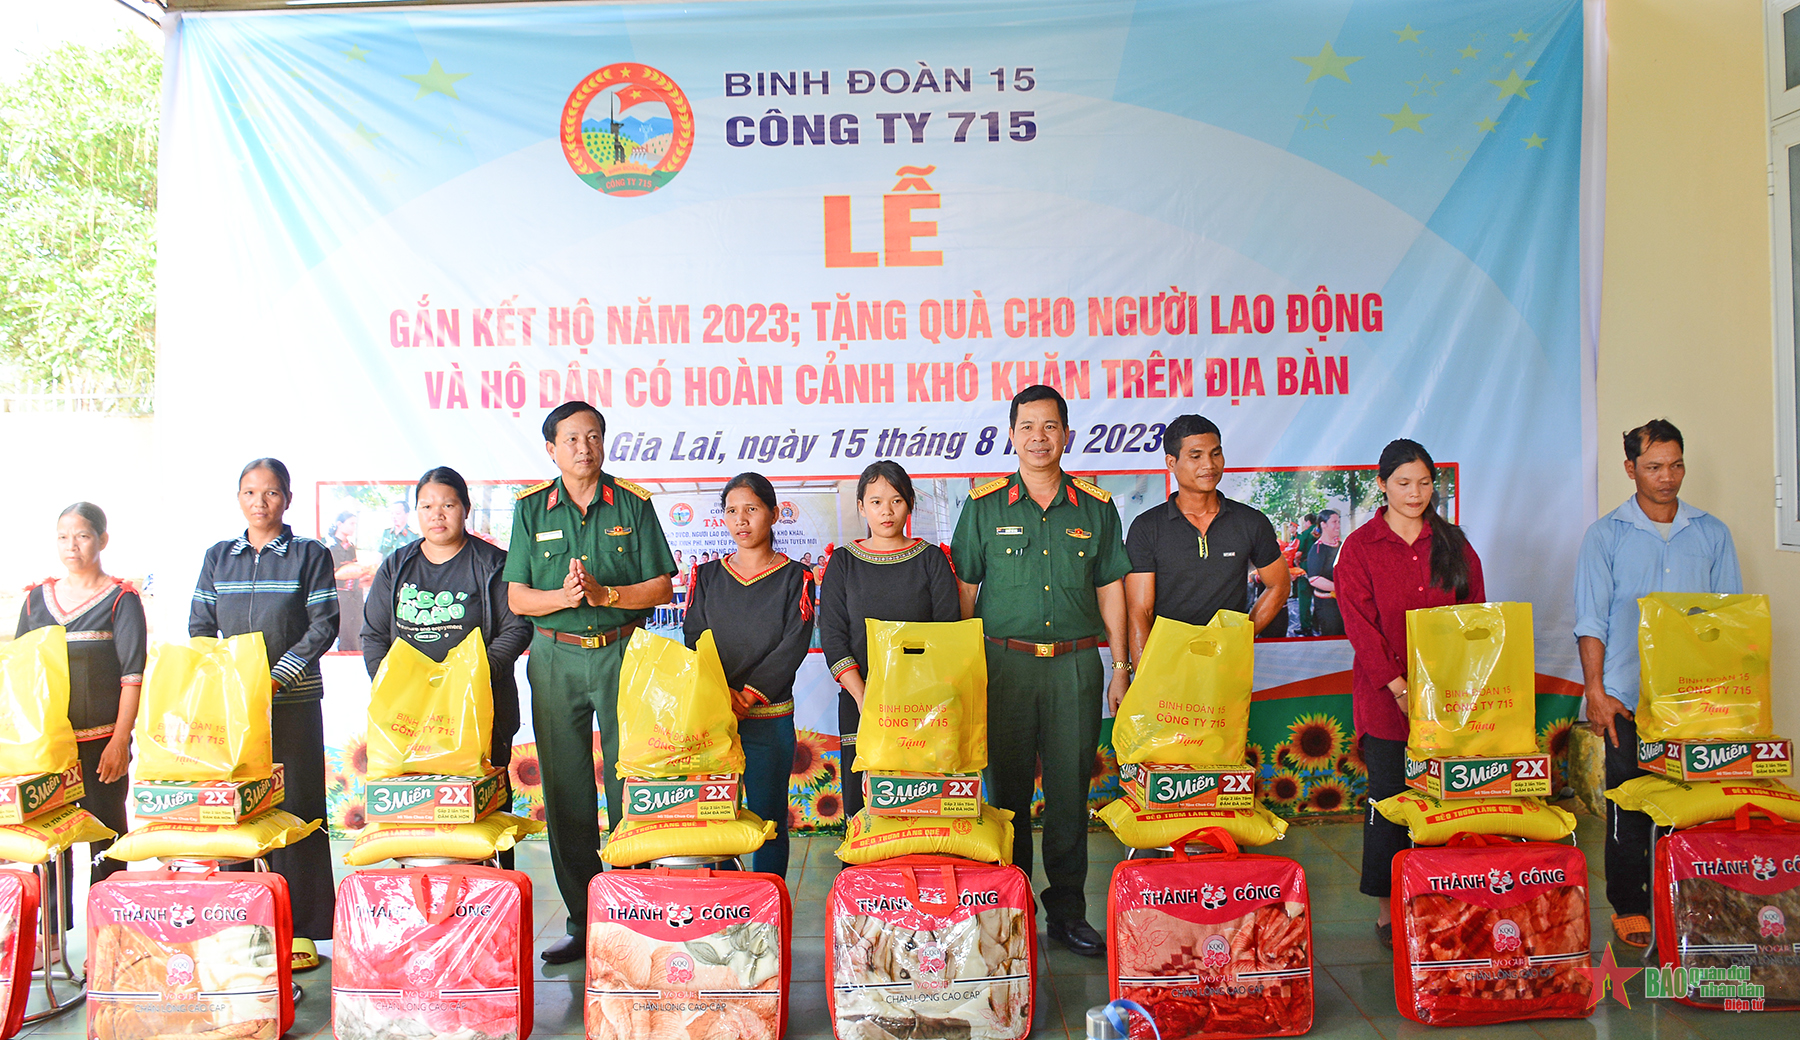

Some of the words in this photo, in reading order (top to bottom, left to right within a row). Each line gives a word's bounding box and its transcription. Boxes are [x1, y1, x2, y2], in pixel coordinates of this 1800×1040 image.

[724, 70, 830, 97] BINH
[846, 60, 972, 95] ĐOÀN
[989, 67, 1036, 93] 15
[725, 108, 860, 147] CÔNG
[875, 111, 932, 144] TY
[947, 110, 1038, 143] 715
[606, 178, 626, 189] CÔNG
[627, 178, 637, 186] TY
[639, 178, 652, 188] 715
[823, 164, 944, 269] LỄ
[389, 294, 461, 348] GẮN
[472, 294, 537, 348] KẾT
[548, 298, 595, 355] HỘ
[607, 296, 691, 346] NĂM
[702, 301, 801, 348] 2023;
[811, 292, 907, 350] TẶNG
[919, 289, 993, 343] QUÀ
[1003, 296, 1076, 338] CHO
[1088, 285, 1198, 338] NGƯỜI
[1211, 293, 1275, 335] LAO
[1287, 285, 1384, 342] ĐỘNG
[424, 358, 469, 410] VÀ
[481, 361, 526, 418] HỘ
[538, 361, 613, 408] DÂN
[625, 358, 672, 407] CÓ
[684, 357, 782, 407] HOÀN
[799, 350, 895, 405] CẢNH
[907, 353, 979, 402] KHÓ
[991, 352, 1091, 401] KHĂN
[1101, 350, 1194, 400] TRÊN
[1204, 357, 1267, 406] ĐỊA
[1276, 348, 1349, 396] BÀN
[608, 430, 666, 463] Gia
[669, 428, 727, 466] Lai,
[737, 427, 820, 467] ngày
[829, 428, 870, 458] 15
[877, 425, 967, 462] tháng
[974, 425, 999, 456] 8
[1082, 422, 1166, 454] 2023
[1678, 676, 1703, 685] BINH
[1739, 673, 1750, 681] 15
[1445, 688, 1469, 698] BINH
[1472, 685, 1498, 698] ĐOÀN
[1499, 685, 1511, 695] 15
[1678, 684, 1712, 695] CÔNG
[1717, 685, 1730, 694] TY
[1733, 685, 1752, 695] 715
[879, 703, 901, 713] BINH
[903, 702, 932, 713] ĐOÀN
[1158, 699, 1183, 711] BINH
[1185, 702, 1214, 715] ĐOÀN
[1217, 705, 1226, 714] 15
[1445, 700, 1478, 713] CÔNG
[1481, 700, 1494, 710] TY
[1497, 699, 1514, 709] 715
[396, 712, 420, 728] BINH
[879, 716, 909, 728] CÔNG
[912, 718, 926, 727] TY
[930, 717, 949, 728] 715
[1156, 712, 1189, 726] CÔNG
[1193, 717, 1207, 727] TY
[1210, 718, 1226, 728] 715
[1467, 720, 1496, 733] Tặng
[438, 726, 455, 737] 715
[648, 737, 676, 753] CÔNG
[696, 738, 714, 751] 715
[896, 736, 927, 749] Tặng
[1754, 742, 1786, 760] 2X
[1515, 760, 1546, 779] 2X
[948, 781, 974, 796] 2X
[1222, 774, 1252, 793] 2X
[203, 791, 230, 805] 2X
[439, 786, 469, 805] 2X
[705, 785, 731, 800] 2X
[1691, 857, 1750, 876] THÀNH
[1428, 872, 1487, 891] THÀNH
[1519, 867, 1566, 886] CÔNG
[1140, 887, 1198, 906] THÀNH
[1233, 883, 1282, 901] CÔNG
[201, 903, 247, 921] CÔNG
[607, 905, 663, 921] THÀNH
[700, 903, 751, 920] CÔNG
